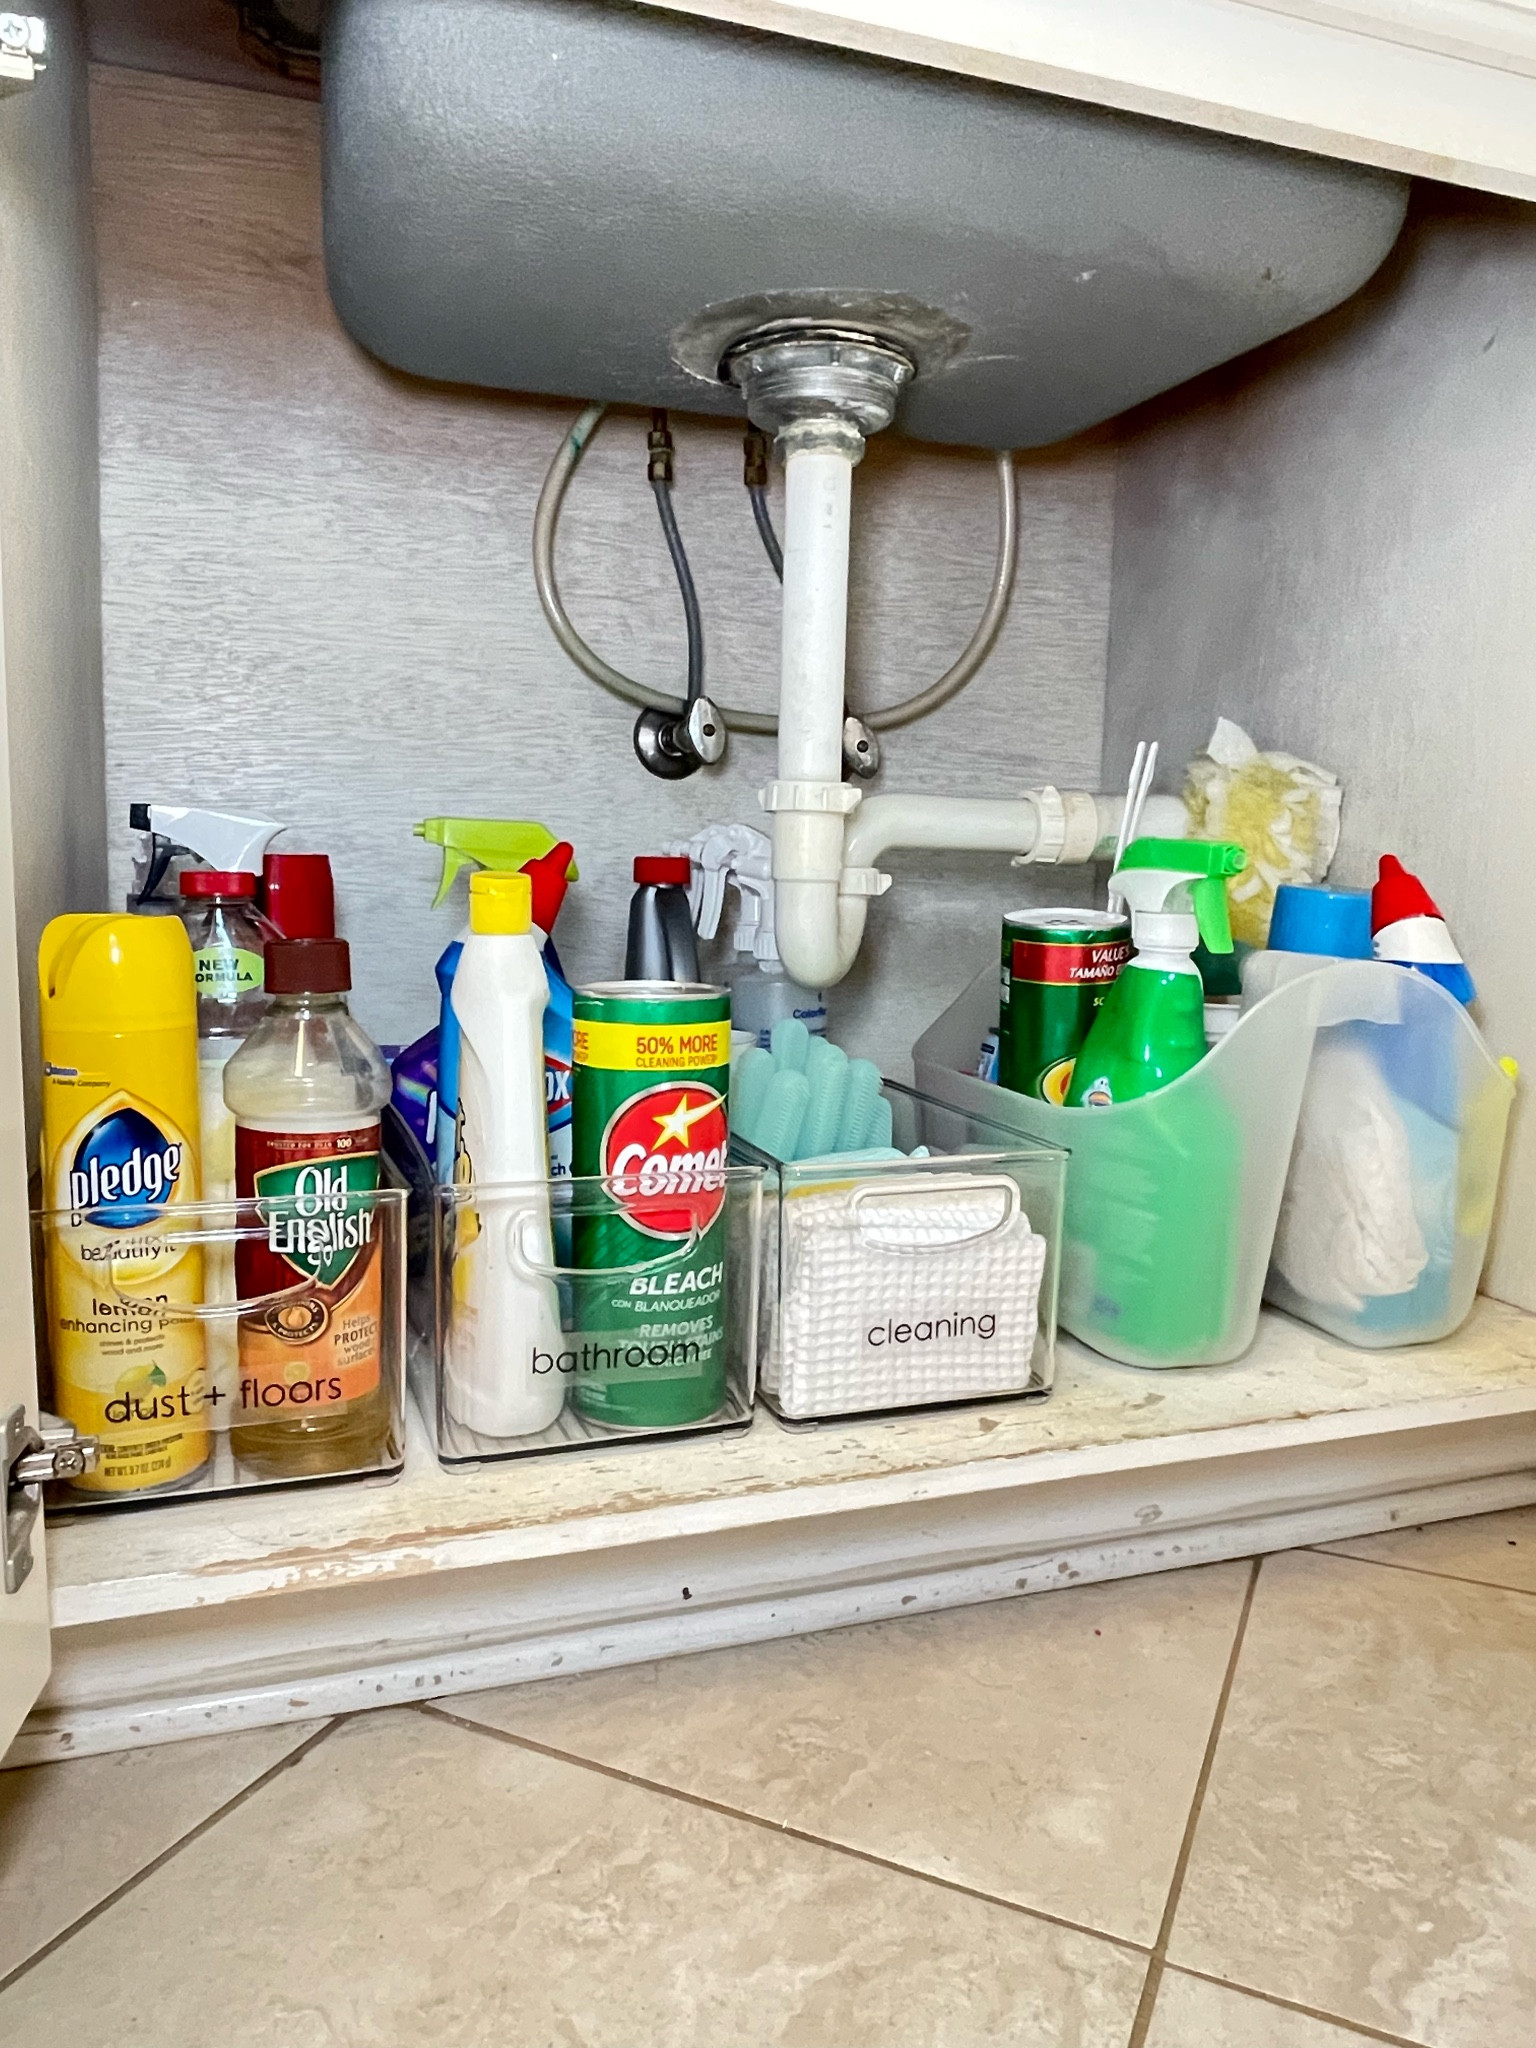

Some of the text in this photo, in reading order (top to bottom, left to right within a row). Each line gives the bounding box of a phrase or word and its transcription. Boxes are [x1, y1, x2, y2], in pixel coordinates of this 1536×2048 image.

[199, 958, 239, 971] NEW
[1069, 964, 1115, 978] TAMAÑO
[194, 971, 254, 983] ORMULA
[636, 1033, 718, 1055] 50% MORE
[635, 1056, 685, 1069] CLEANING
[336, 1137, 352, 1149] 100
[71, 1143, 181, 1211] pledge
[295, 1165, 348, 1217] Old
[269, 1208, 372, 1266] English
[629, 1262, 724, 1295] BLEACH
[634, 1289, 721, 1313] BLANQUEADOR
[60, 1317, 153, 1335] enhancing
[342, 1313, 371, 1331] Helps
[639, 1314, 714, 1338] REMOVES
[867, 1310, 997, 1347] cleaning
[344, 1339, 371, 1354] wood
[532, 1342, 700, 1375] bathroom
[104, 1386, 191, 1423] dust
[203, 1386, 227, 1407] +
[240, 1377, 342, 1409] floors
